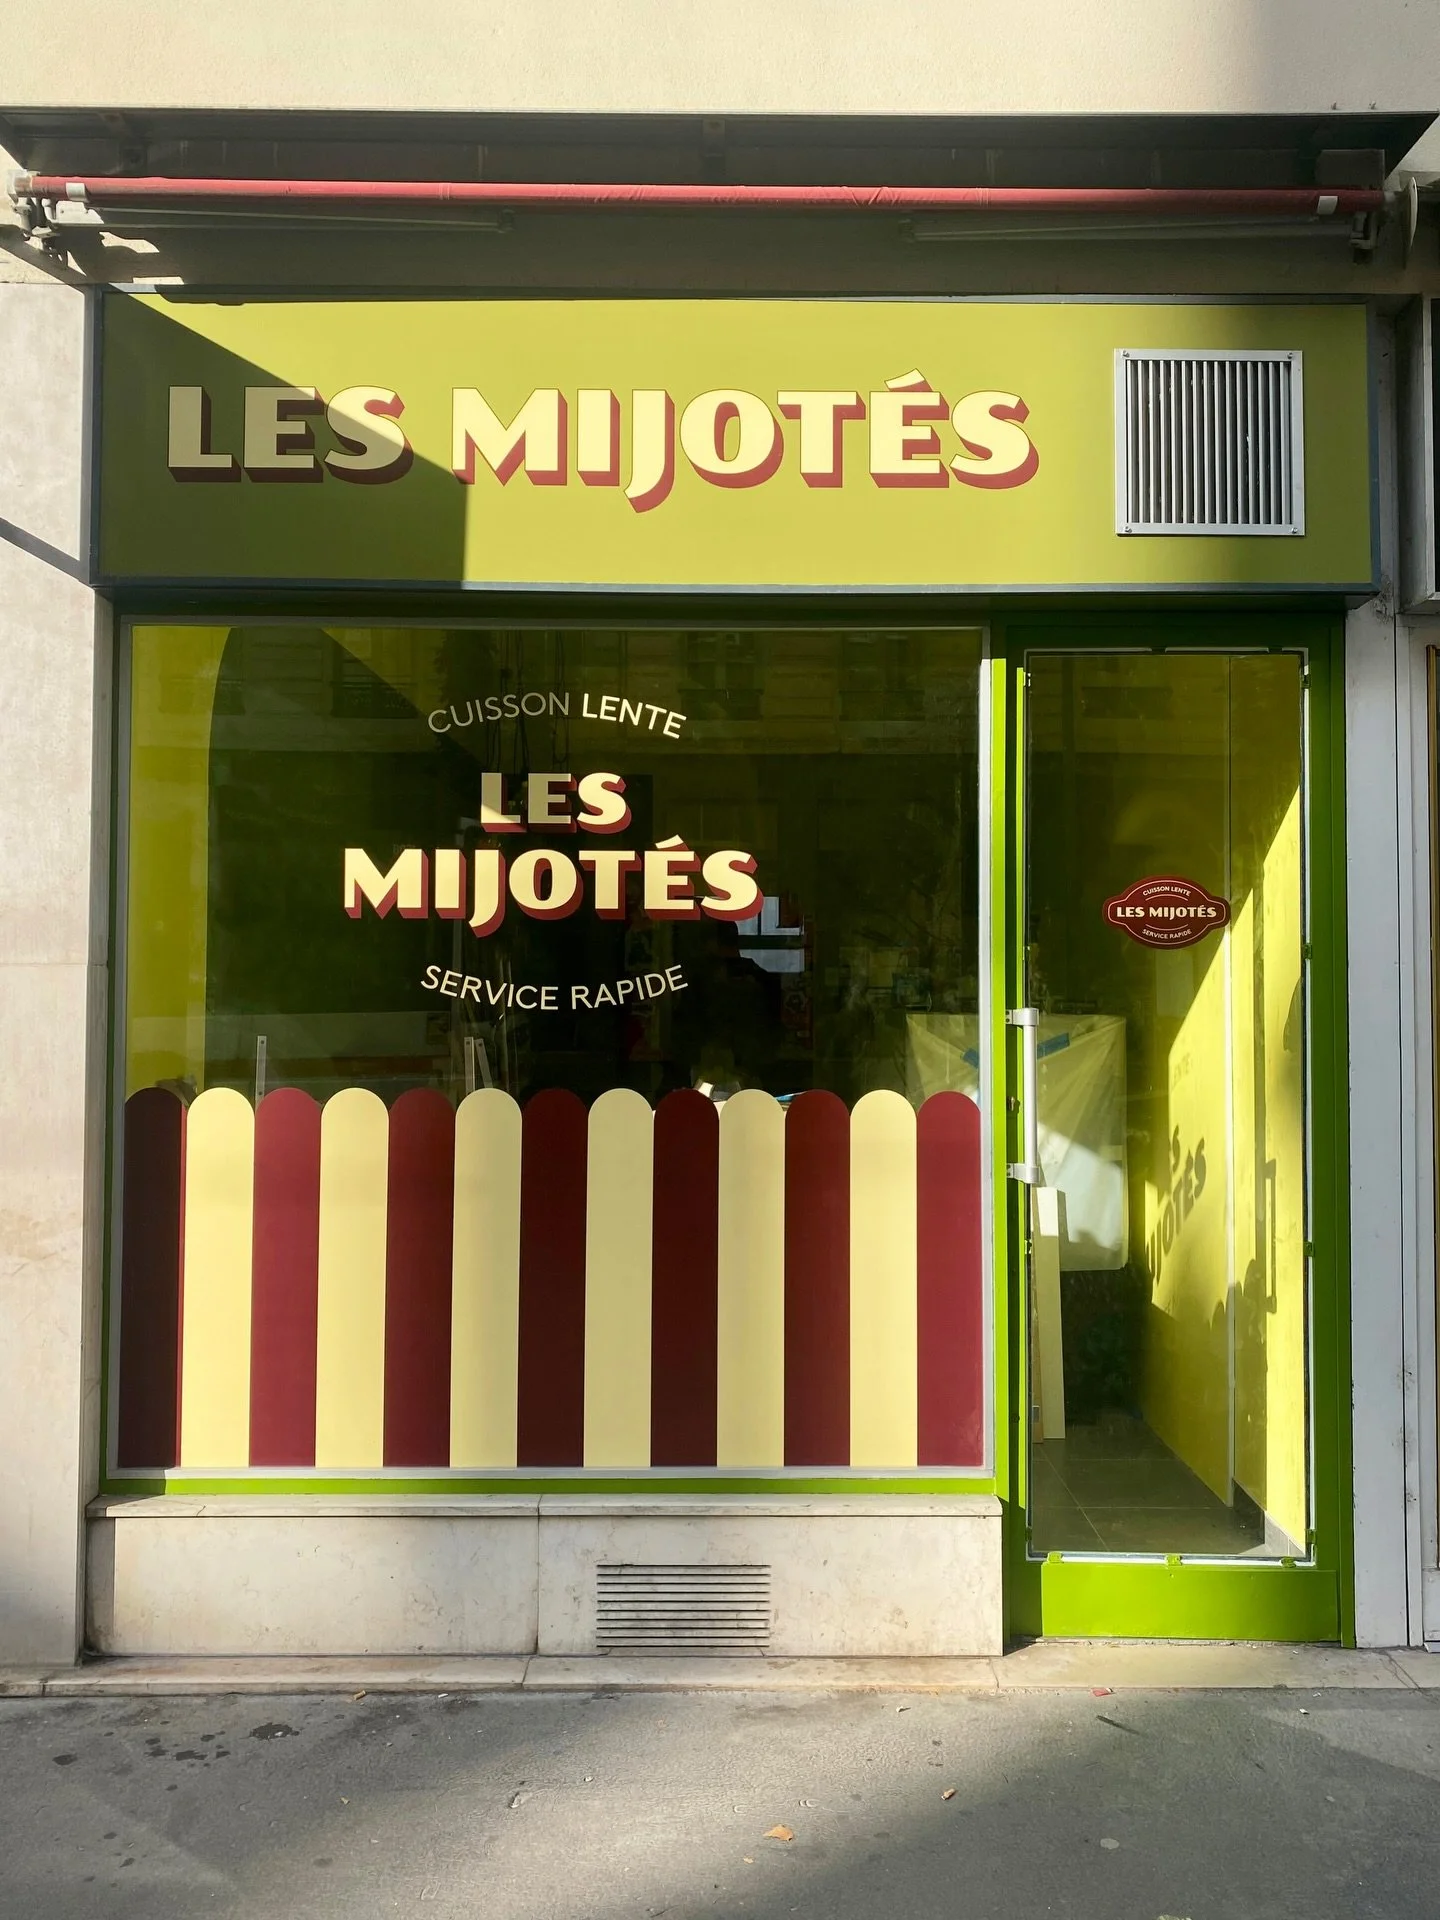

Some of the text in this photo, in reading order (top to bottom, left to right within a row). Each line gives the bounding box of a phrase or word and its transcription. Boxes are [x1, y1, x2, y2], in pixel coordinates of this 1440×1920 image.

[167, 368, 1040, 513] LES MIJOTÉS
[428, 692, 687, 739] CUISSON LENTE
[480, 772, 632, 834] LES
[344, 834, 765, 938] MIJOTÉS
[1142, 886, 1191, 897] CUISSON LENTE
[1116, 905, 1217, 920] LES MIJOTÉS
[1142, 928, 1192, 939] SERVICE RAPIDE
[420, 965, 688, 1010] SERVICE RAPIDE
